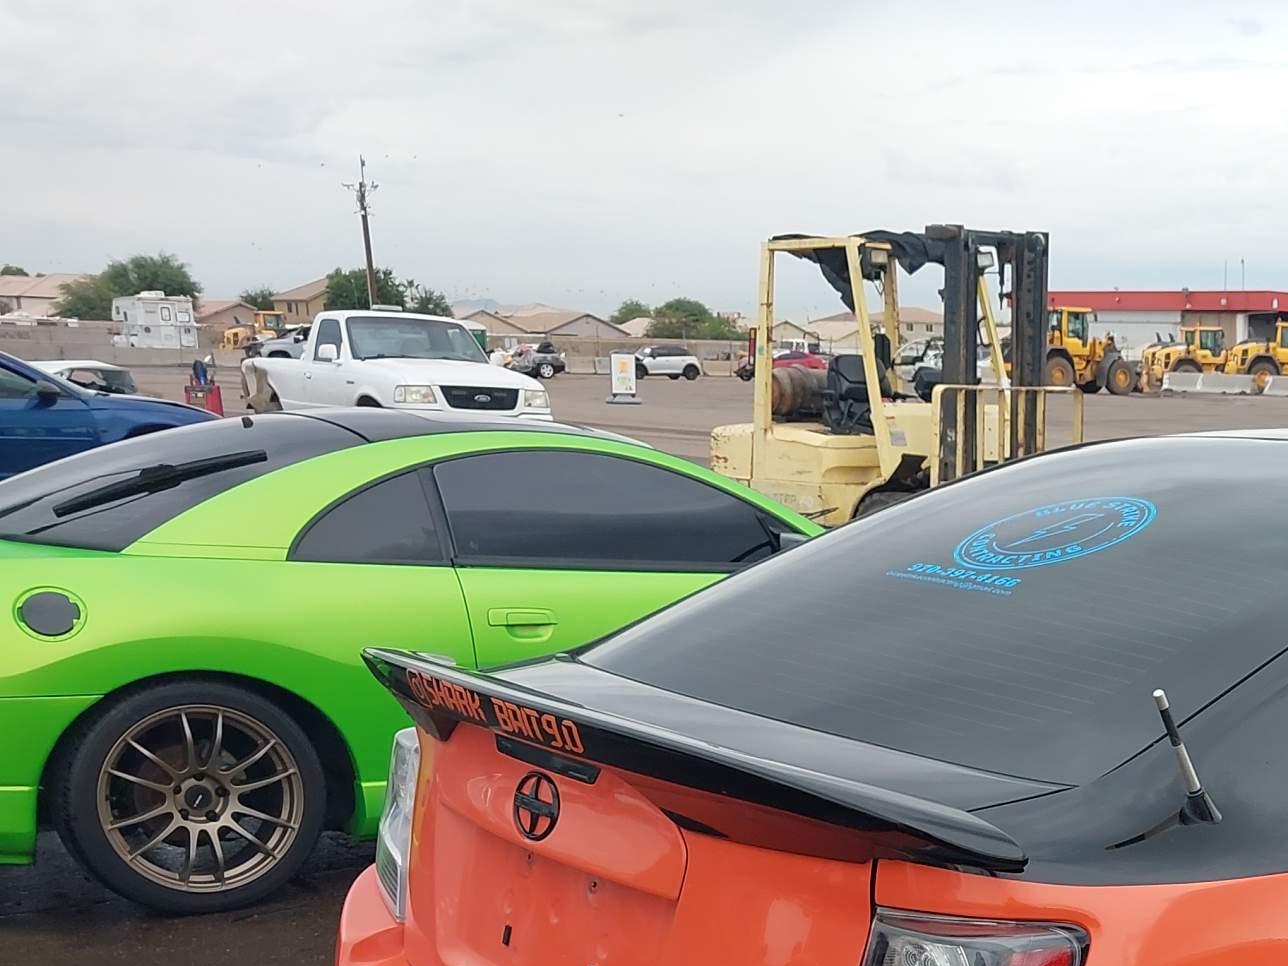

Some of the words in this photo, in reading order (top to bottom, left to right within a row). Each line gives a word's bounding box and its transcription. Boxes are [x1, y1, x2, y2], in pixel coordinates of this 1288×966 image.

[1034, 501, 1102, 518] BLUE
[1103, 501, 1142, 529] STRIKE
[967, 529, 1084, 565] CONTRACTING
